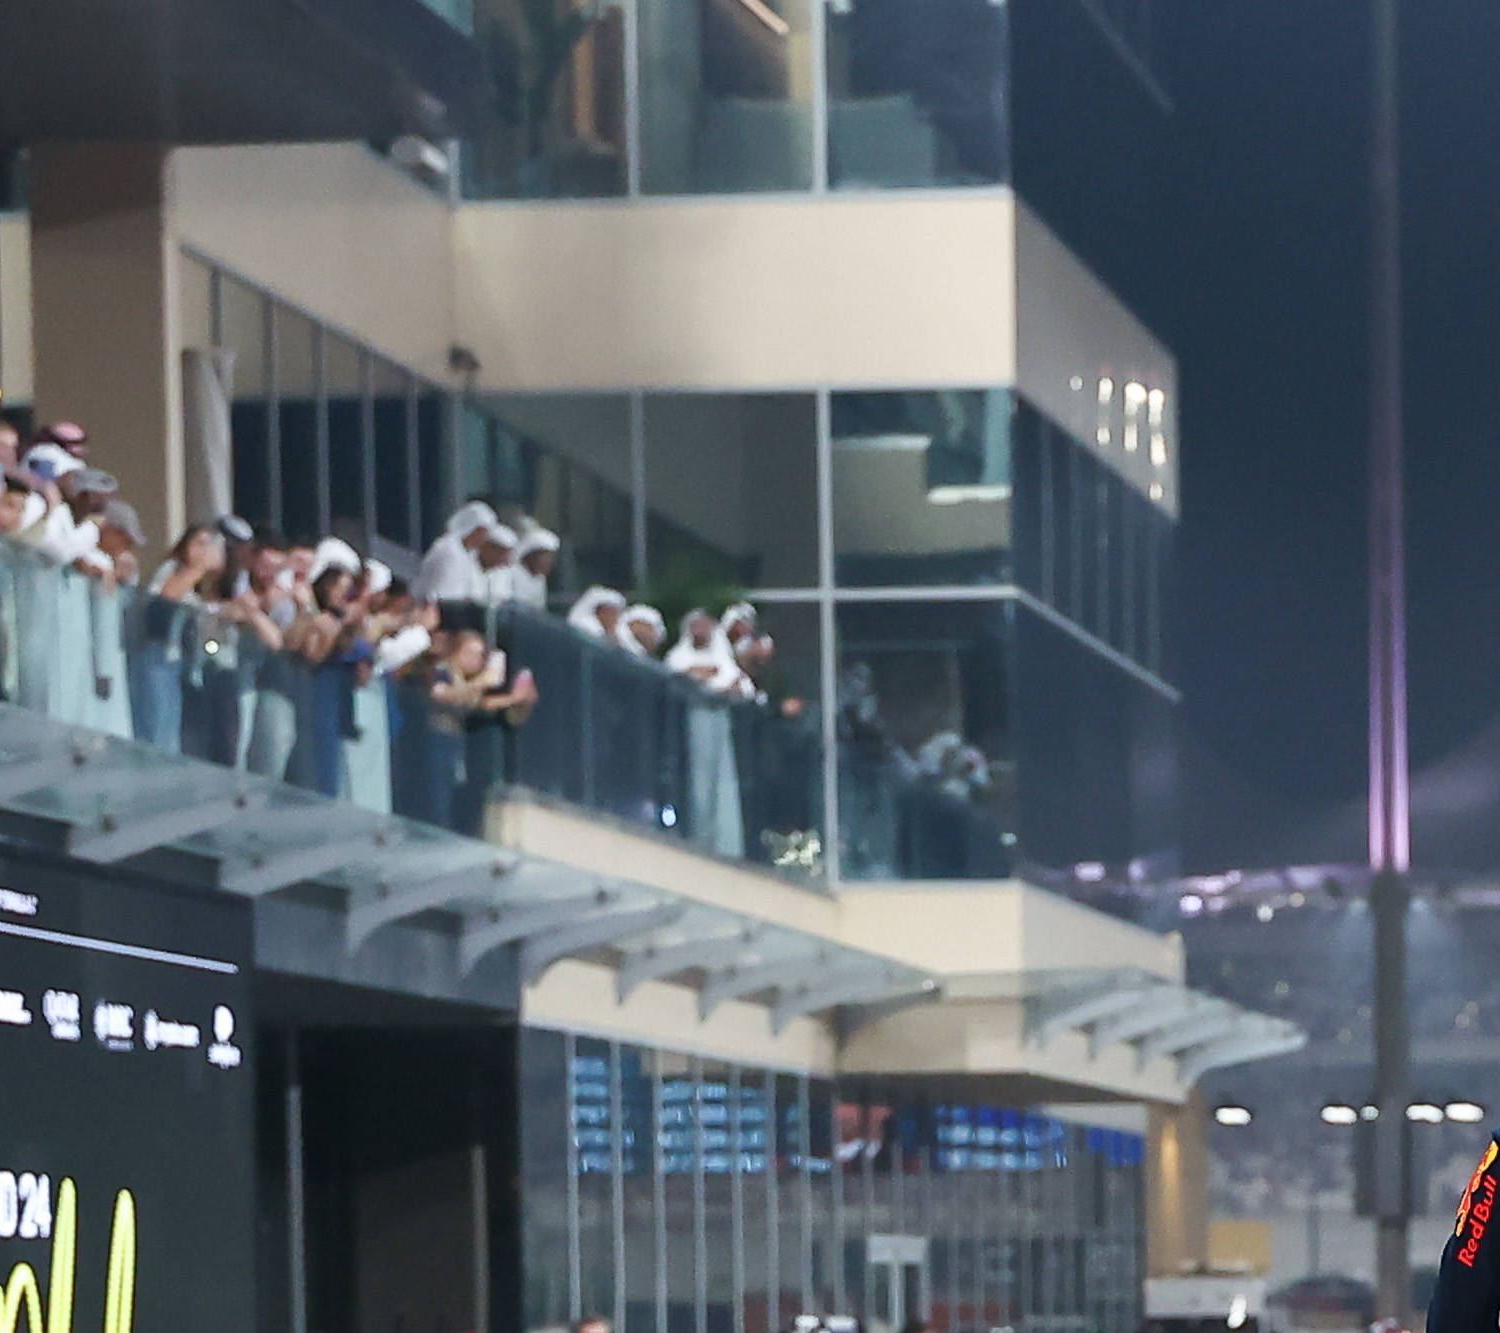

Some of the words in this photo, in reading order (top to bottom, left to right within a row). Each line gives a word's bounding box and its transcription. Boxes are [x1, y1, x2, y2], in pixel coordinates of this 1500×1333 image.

[17, 1171, 52, 1239] 24
[1457, 1217, 1486, 1268] Red
[1472, 1173, 1498, 1223] Bull
